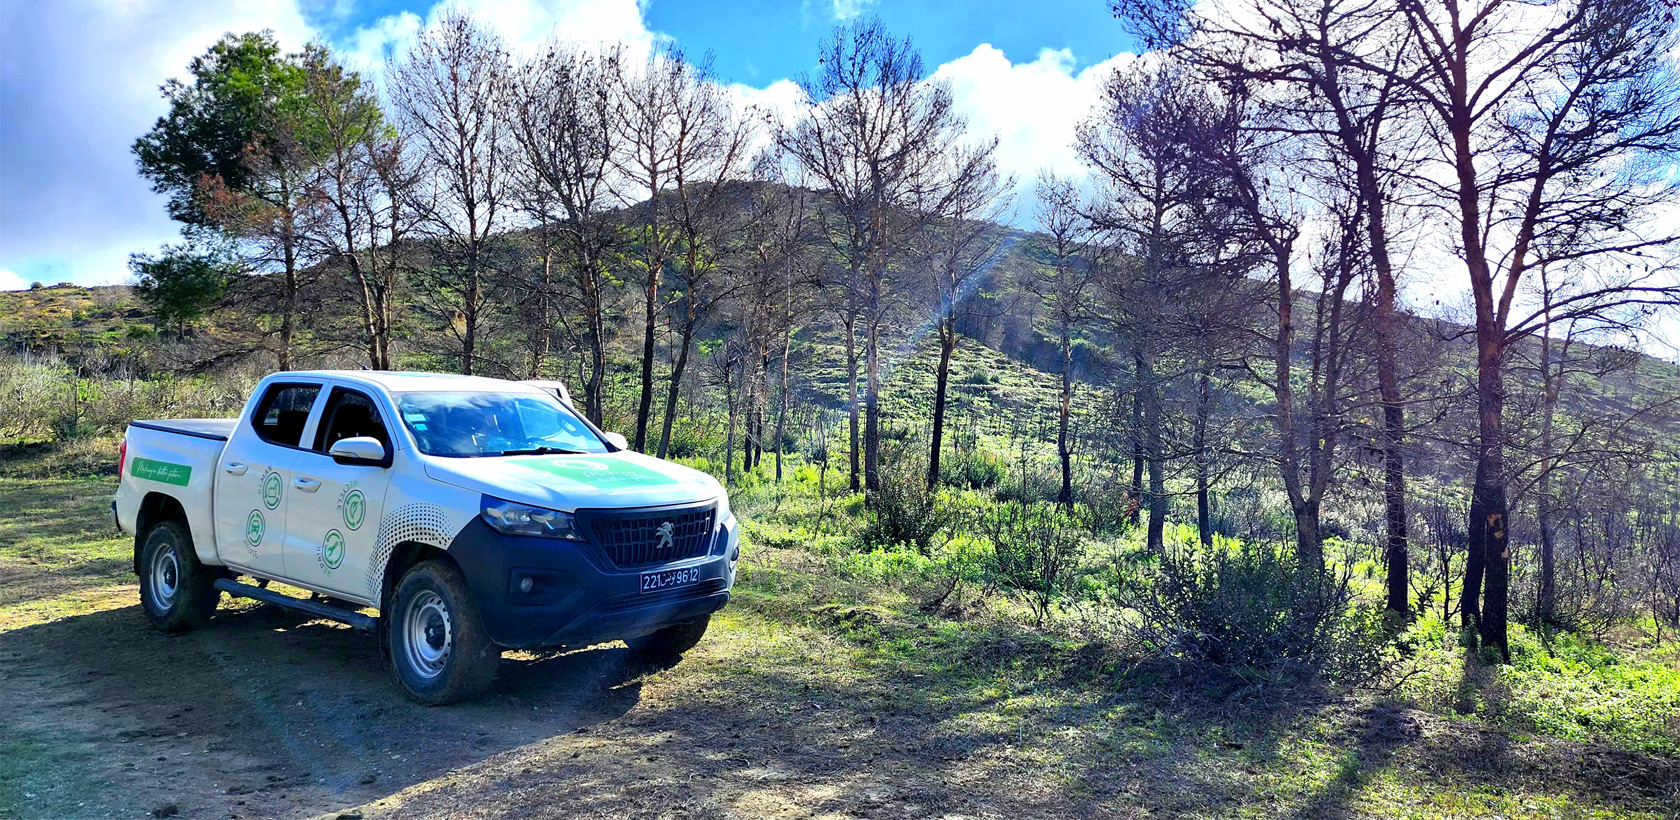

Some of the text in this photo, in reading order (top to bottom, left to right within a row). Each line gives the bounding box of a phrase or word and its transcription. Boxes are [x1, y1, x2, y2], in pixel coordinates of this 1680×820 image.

[336, 479, 359, 510] RECYCLE
[242, 538, 258, 559] REUSE
[315, 545, 331, 578] REPAIR
[643, 573, 661, 590] 221
